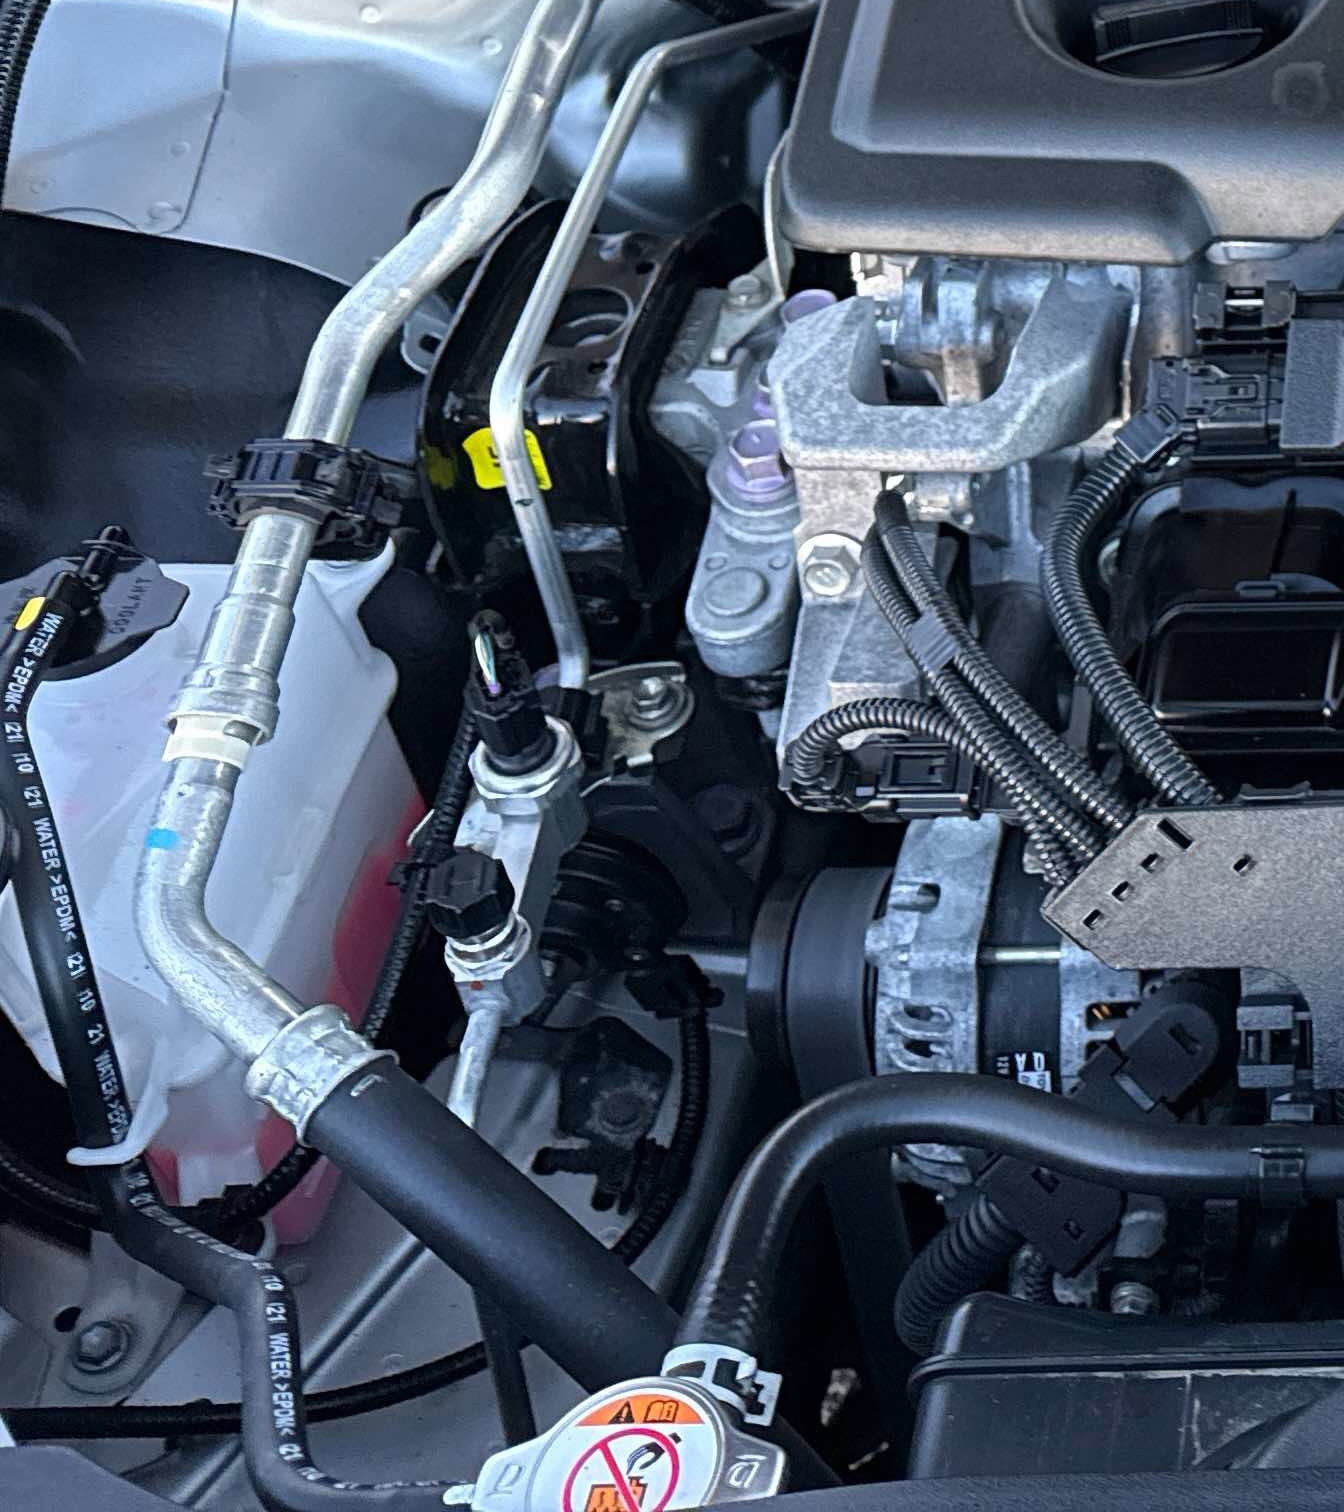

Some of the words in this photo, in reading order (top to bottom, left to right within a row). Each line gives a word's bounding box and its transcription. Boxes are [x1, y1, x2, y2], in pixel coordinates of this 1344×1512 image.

[108, 577, 153, 634] COOLANT
[25, 613, 64, 658] WATER
[33, 817, 61, 871] WATER
[268, 1333, 292, 1381] WATER
